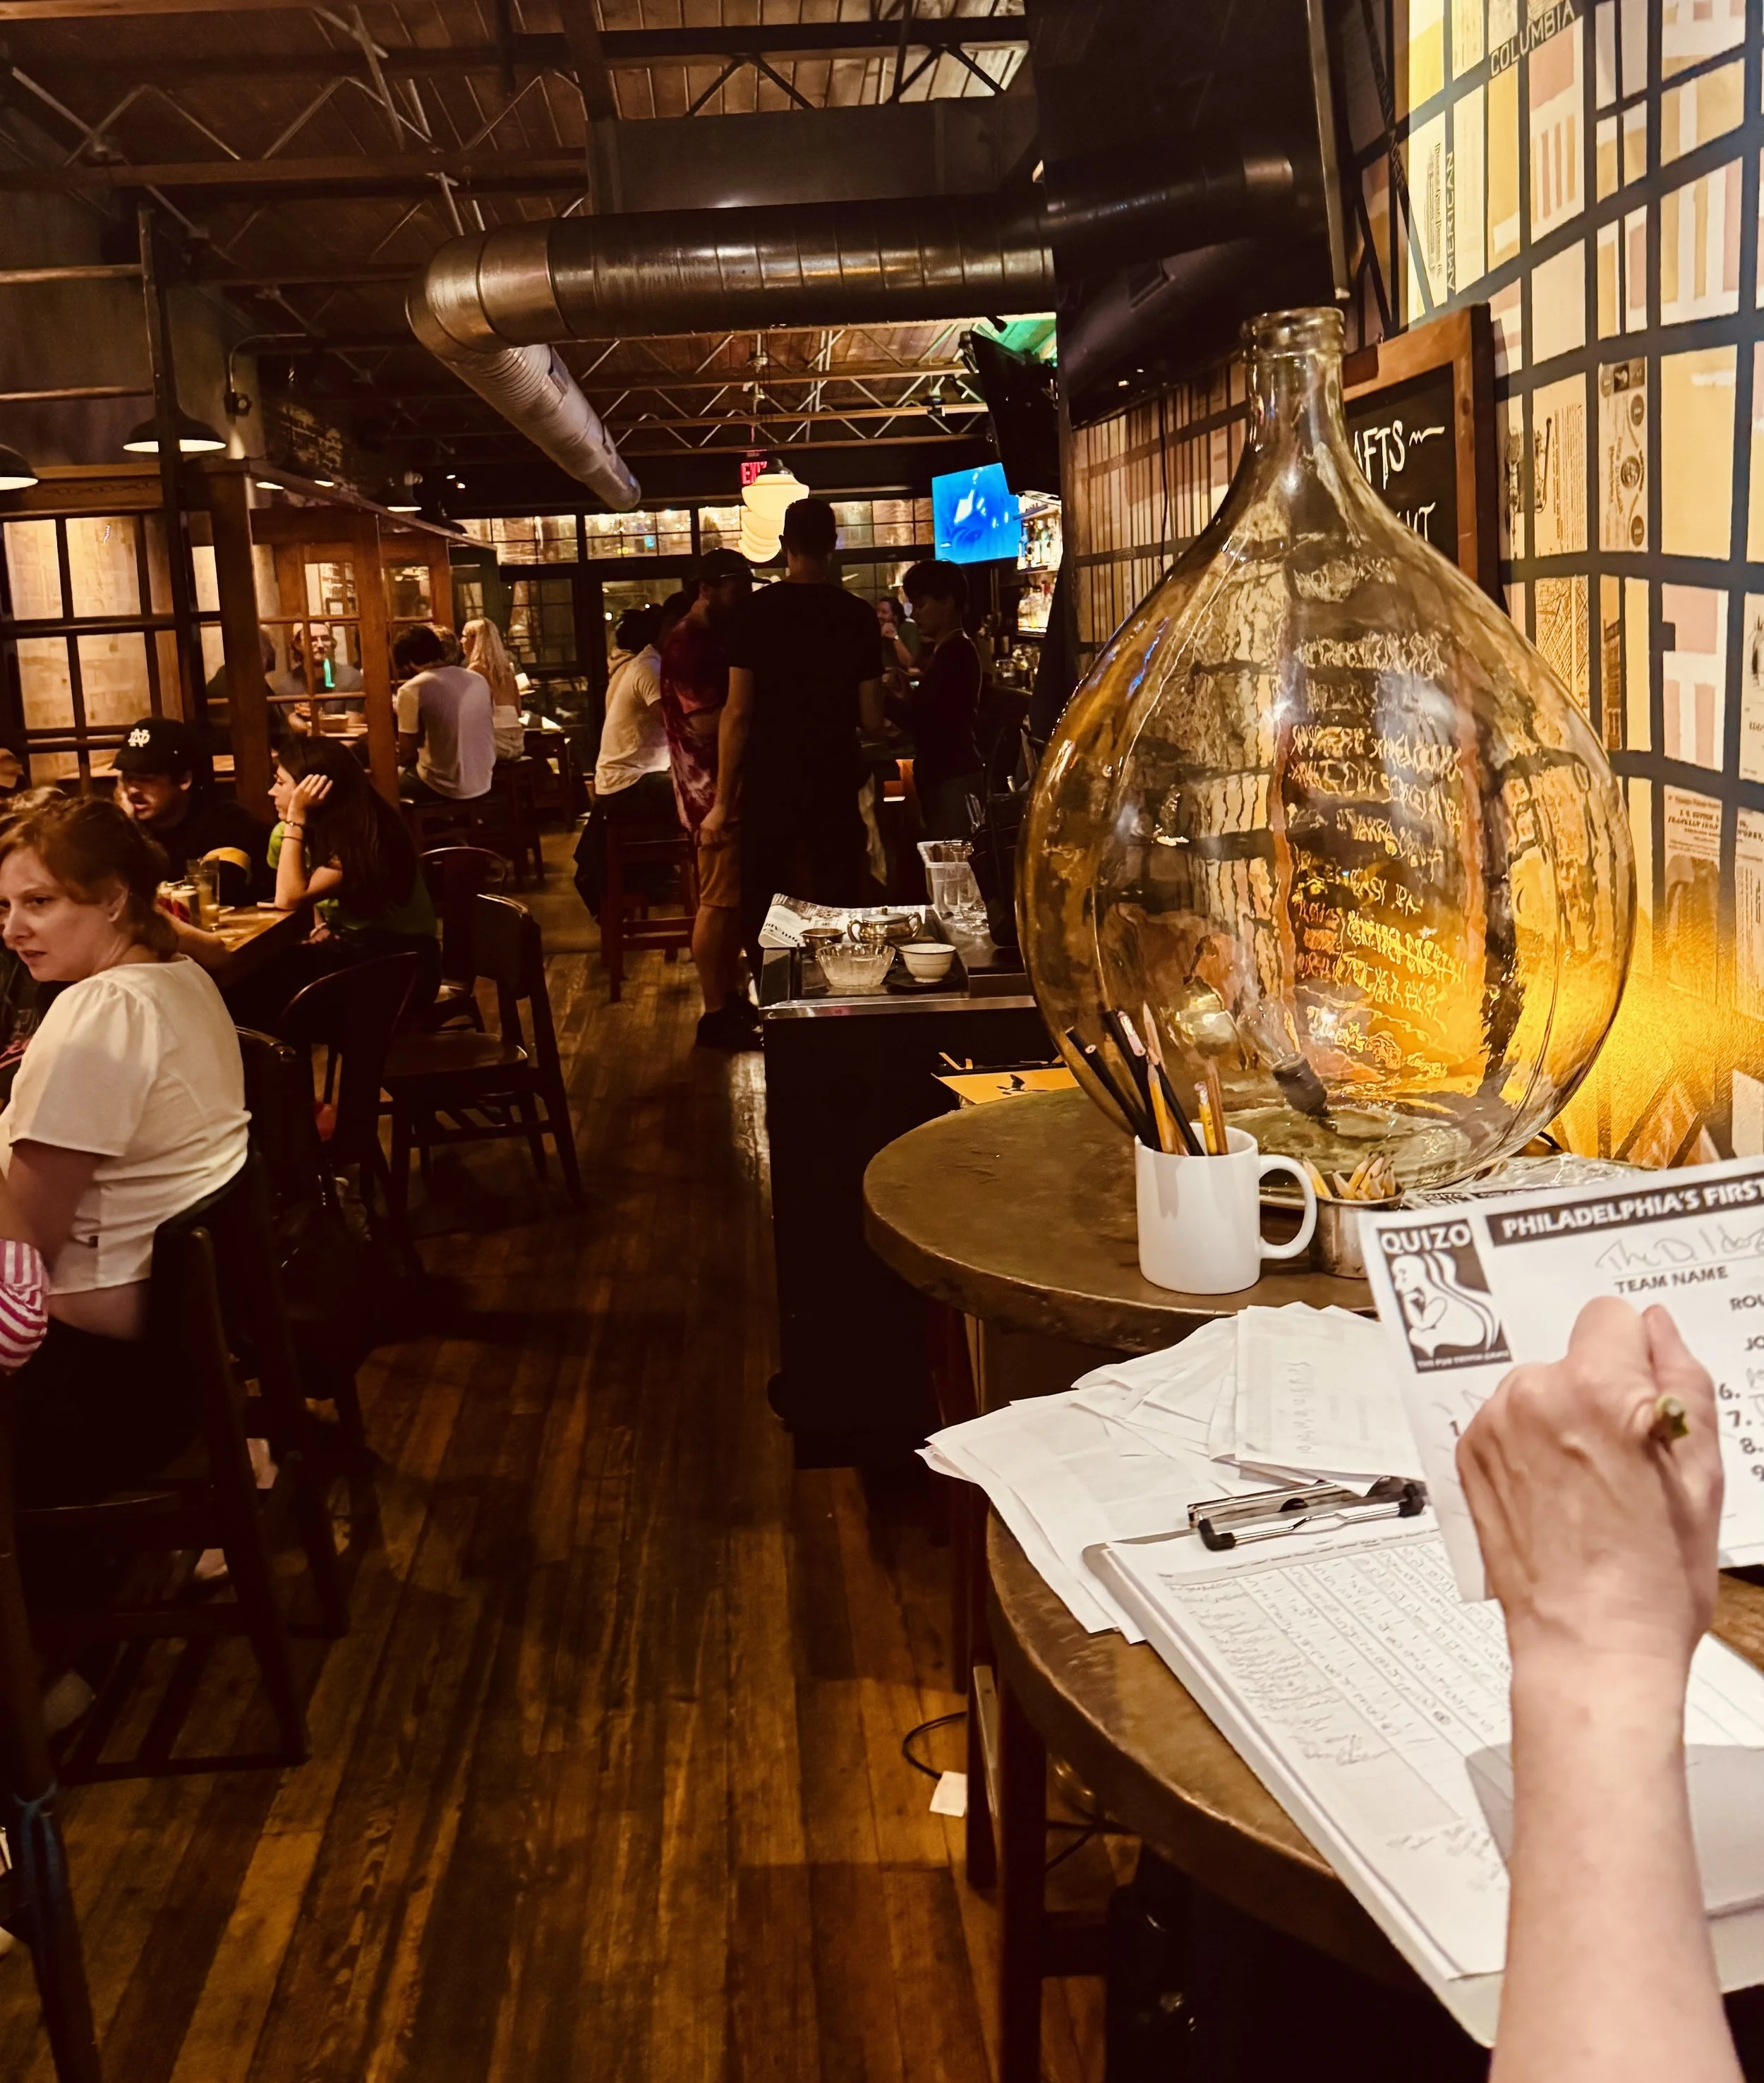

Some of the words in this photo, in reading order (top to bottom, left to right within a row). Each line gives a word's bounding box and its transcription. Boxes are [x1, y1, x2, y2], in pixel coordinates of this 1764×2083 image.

[1491, 0, 1575, 78] COLUMBIA
[1446, 151, 1456, 290] AMERICAN
[1502, 1189, 1700, 1238] PHILADELPHIA'S
[1703, 1178, 1764, 1207] FIRST
[1381, 1224, 1471, 1254] QUIZO
[1614, 1275, 1667, 1294] TEAM
[1672, 1265, 1729, 1286] NAME
[1719, 1382, 1741, 1400] 6.
[1724, 1410, 1752, 1427] 7.
